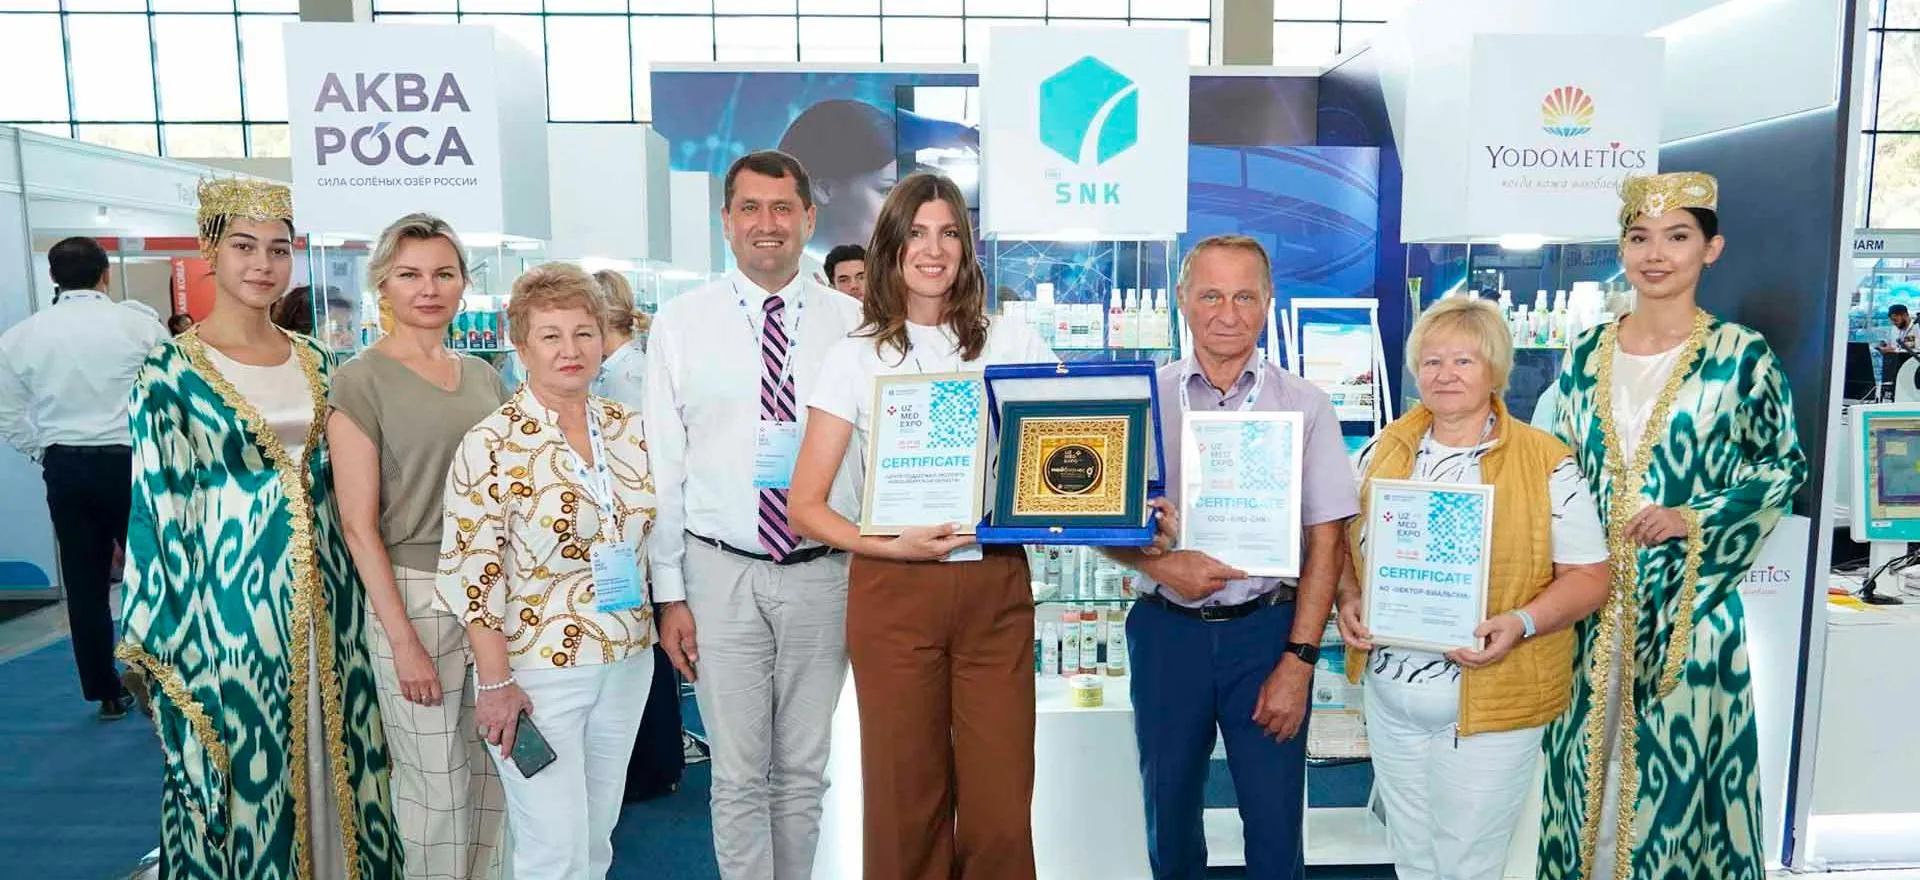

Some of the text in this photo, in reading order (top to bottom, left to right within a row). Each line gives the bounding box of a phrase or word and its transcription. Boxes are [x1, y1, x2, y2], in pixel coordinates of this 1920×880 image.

[314, 72, 471, 112] АКВА
[318, 175, 478, 187] СИЛА СОЛЁНЫХ ОЗЁР РОССИИ
[1055, 182, 1121, 205] SNK
[900, 404, 913, 412] UZ
[900, 412, 920, 420] MED
[899, 420, 922, 428] EXPO
[881, 455, 971, 469] CERTIFICATE
[1398, 512, 1410, 520] UZ
[1397, 521, 1418, 529] MED
[1396, 530, 1421, 538] EXPO
[1379, 566, 1473, 585] CERTIFICATE
